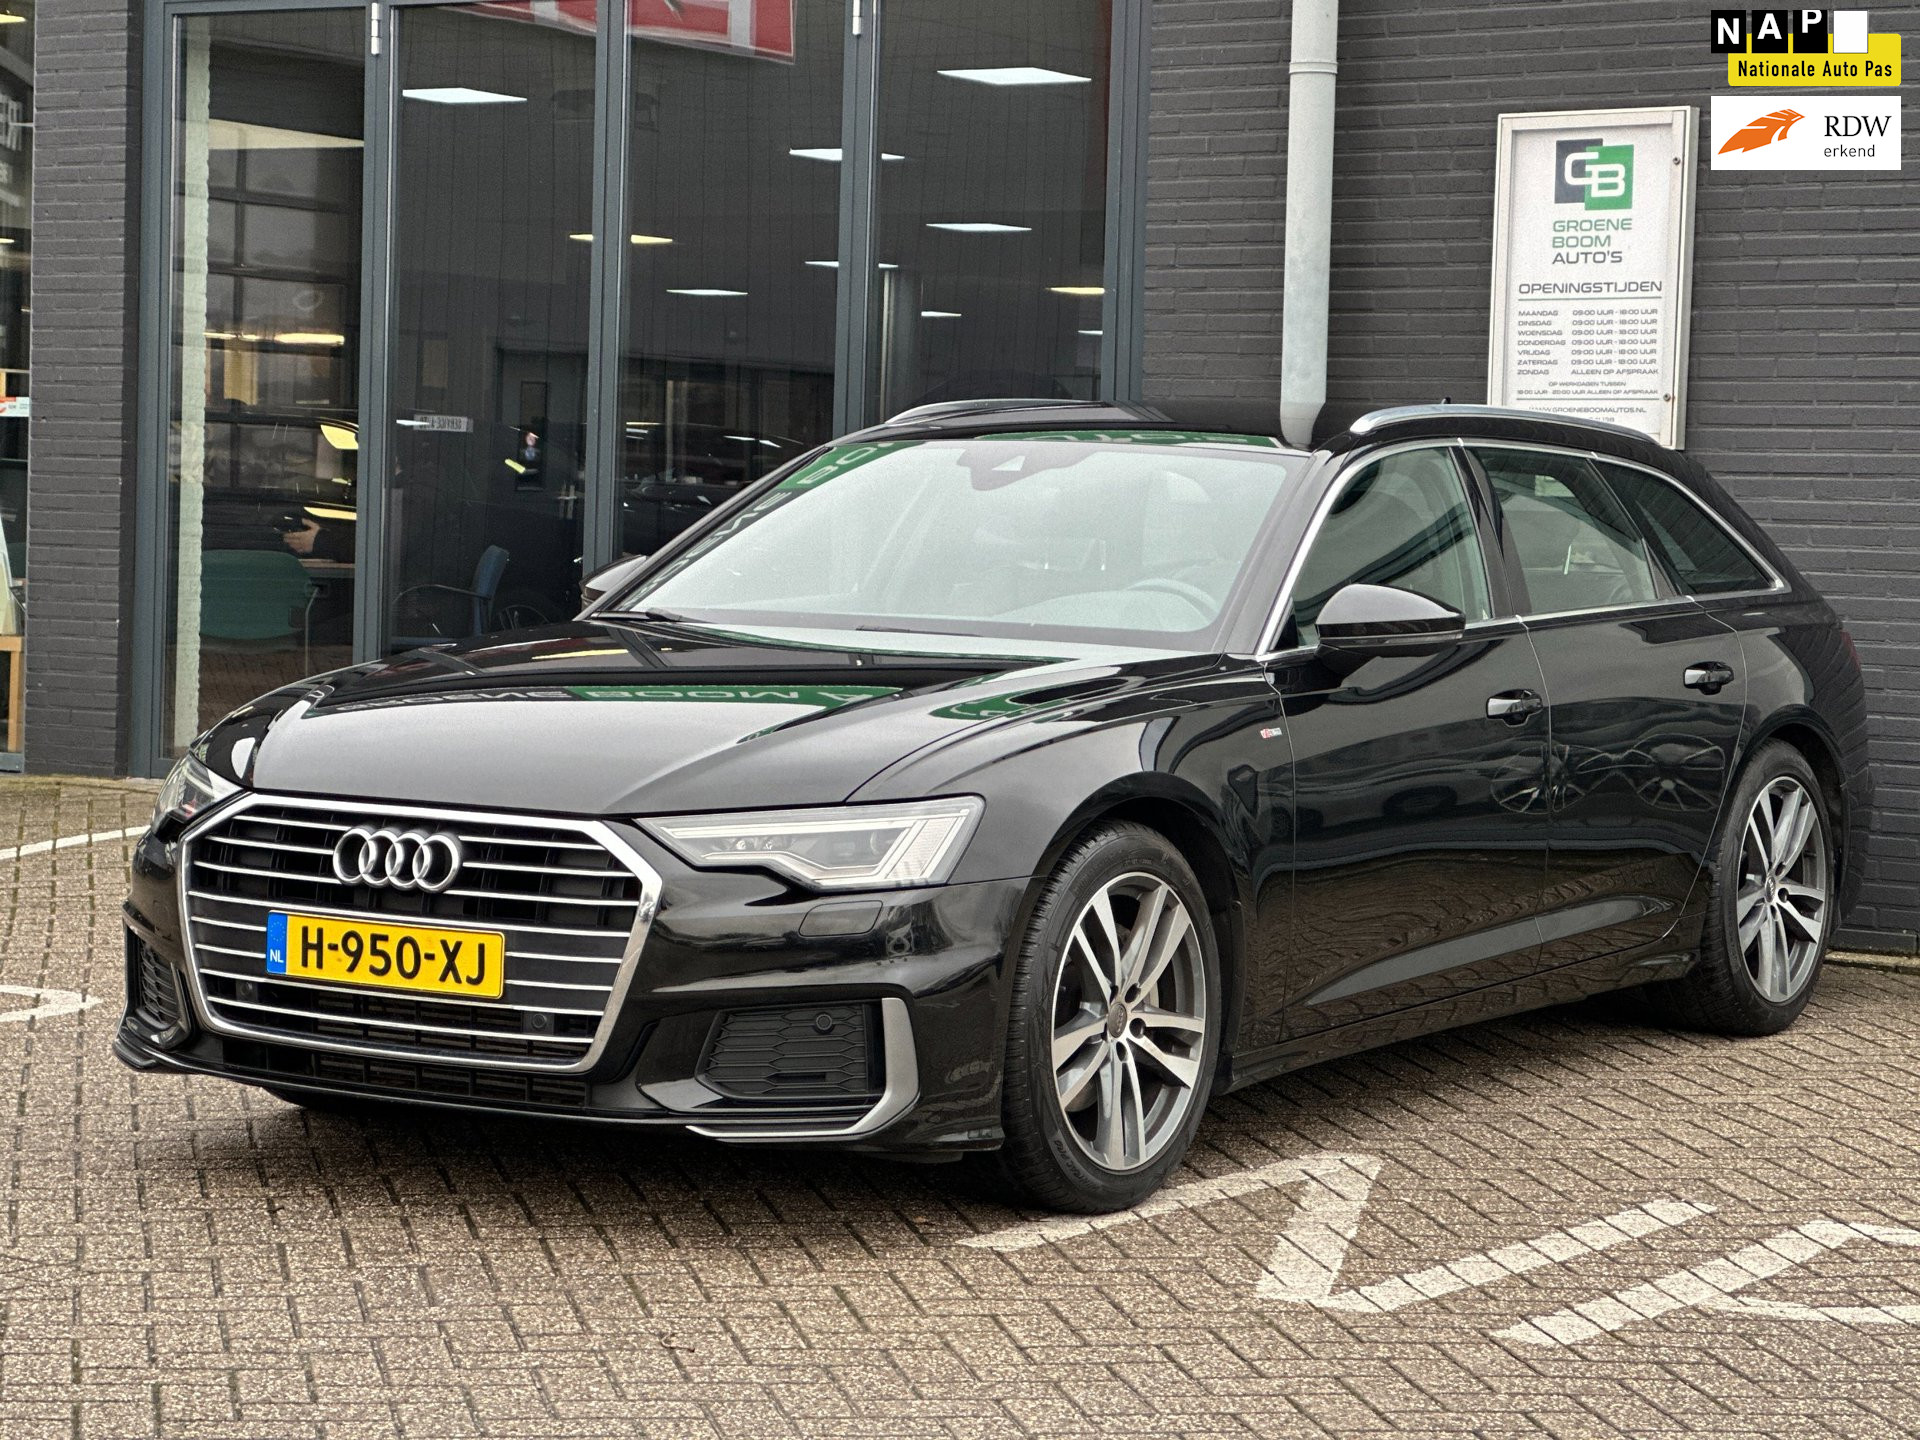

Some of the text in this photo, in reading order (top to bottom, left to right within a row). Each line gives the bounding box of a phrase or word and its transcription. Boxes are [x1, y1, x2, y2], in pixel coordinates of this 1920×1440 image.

[1552, 218, 1633, 232] GROENE
[1552, 235, 1612, 249] BOOM
[1552, 250, 1623, 265] AUTO'S
[1518, 281, 1663, 295] OPENINGSTIJDEN
[269, 949, 284, 964] NL
[301, 924, 486, 987] H-950-XJ
